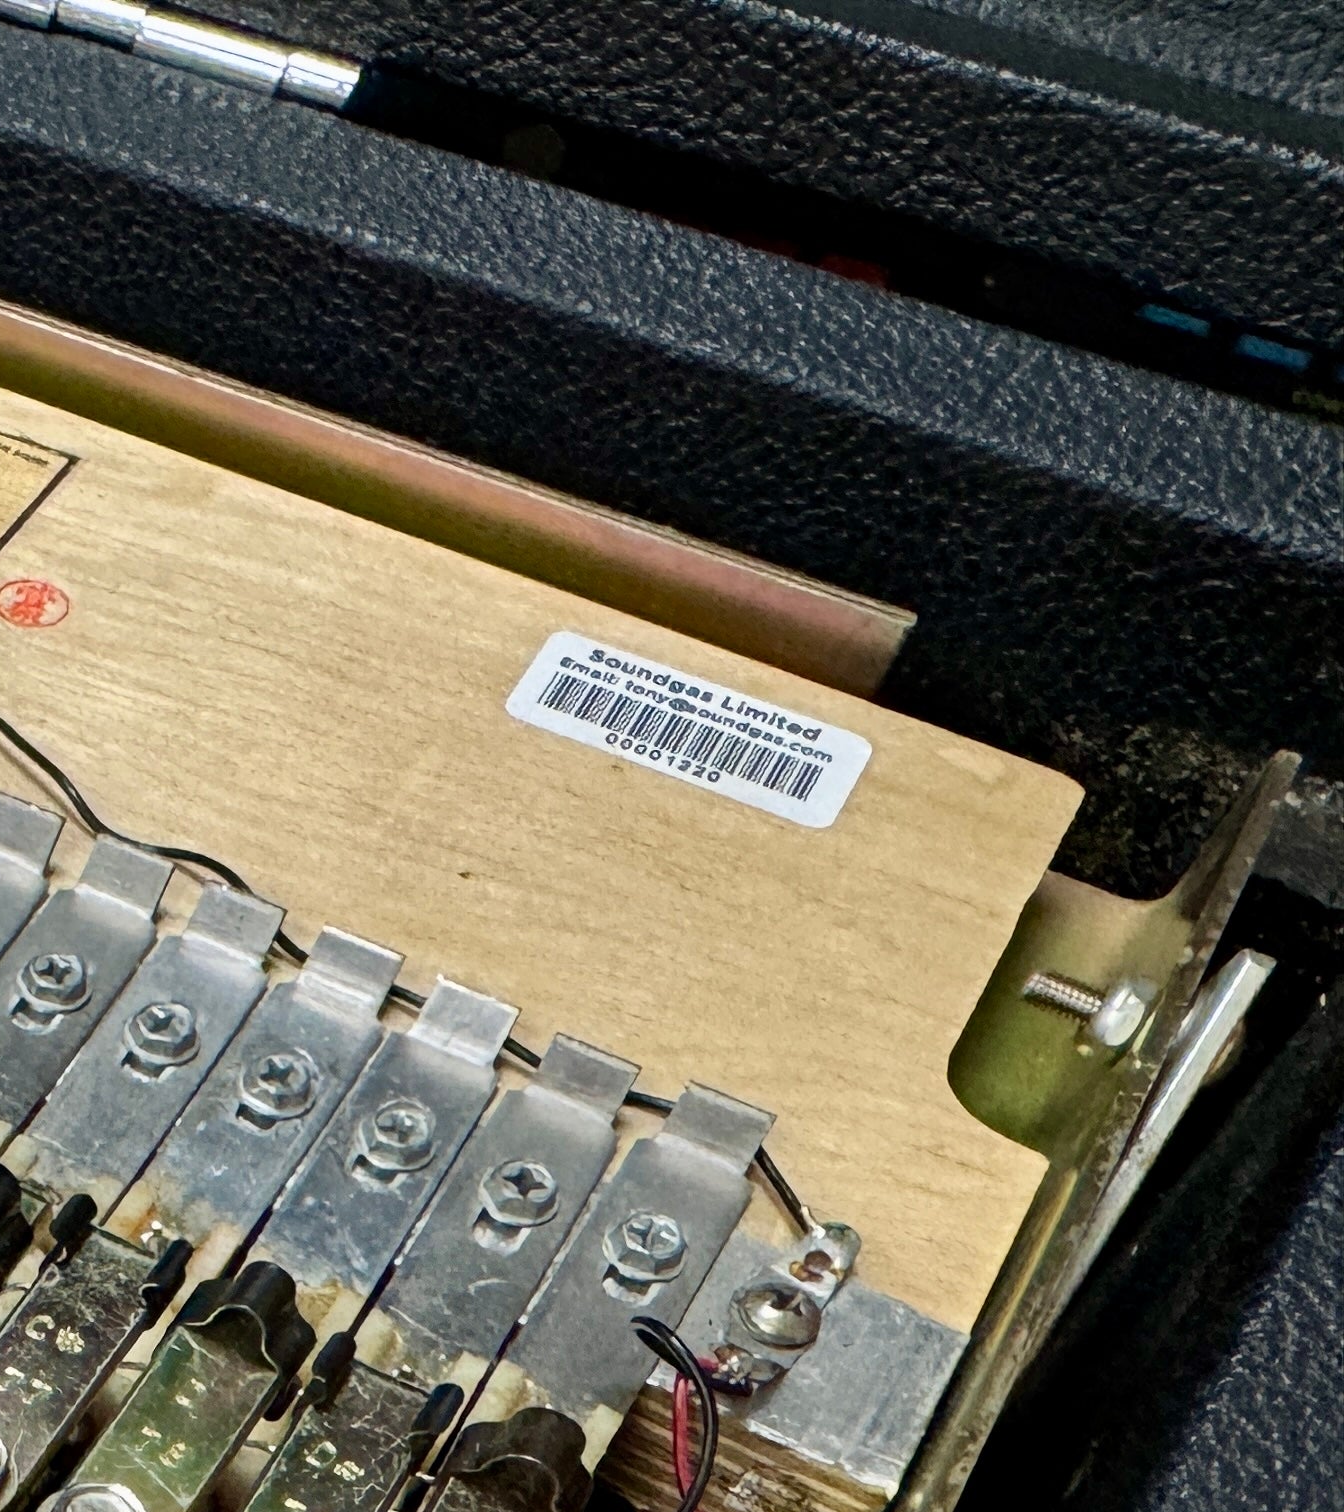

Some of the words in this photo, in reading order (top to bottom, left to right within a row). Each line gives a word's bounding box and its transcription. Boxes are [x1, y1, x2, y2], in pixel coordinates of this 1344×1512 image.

[588, 648, 714, 703] Soundgas
[720, 694, 825, 743] Limited
[624, 679, 835, 765] tony@soundgas.com
[605, 732, 723, 784] 00001220
[24, 1313, 86, 1355] C#
